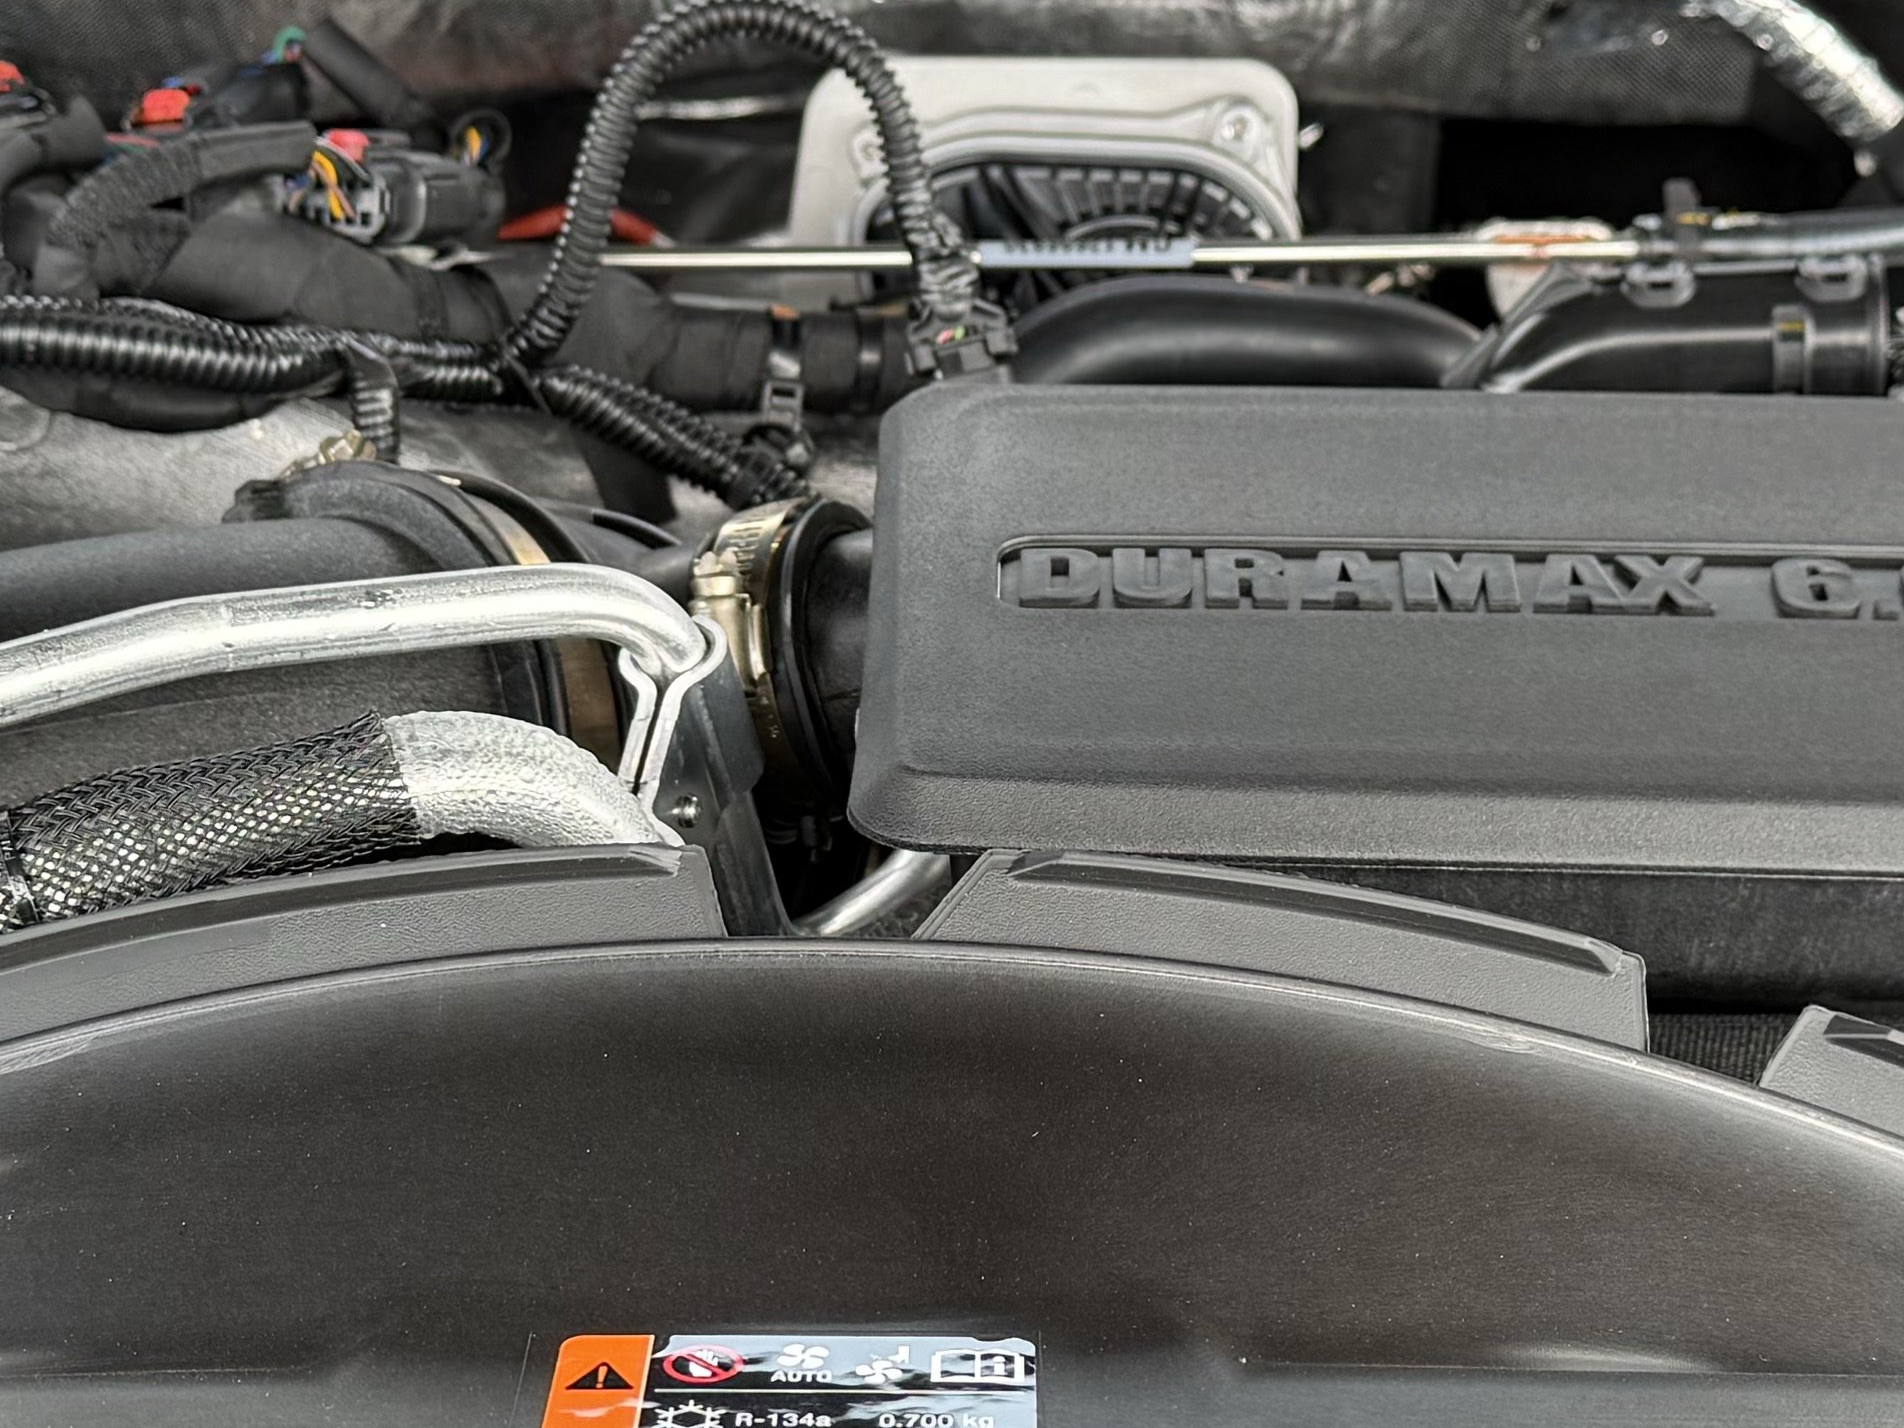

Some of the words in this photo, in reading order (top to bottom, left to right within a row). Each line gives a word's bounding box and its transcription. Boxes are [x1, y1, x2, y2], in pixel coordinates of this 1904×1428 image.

[1018, 547, 1715, 616] DURAMAX
[770, 1369, 832, 1383] AUTO
[734, 1412, 833, 1428] R-134a
[878, 1413, 954, 1428] 0.700
